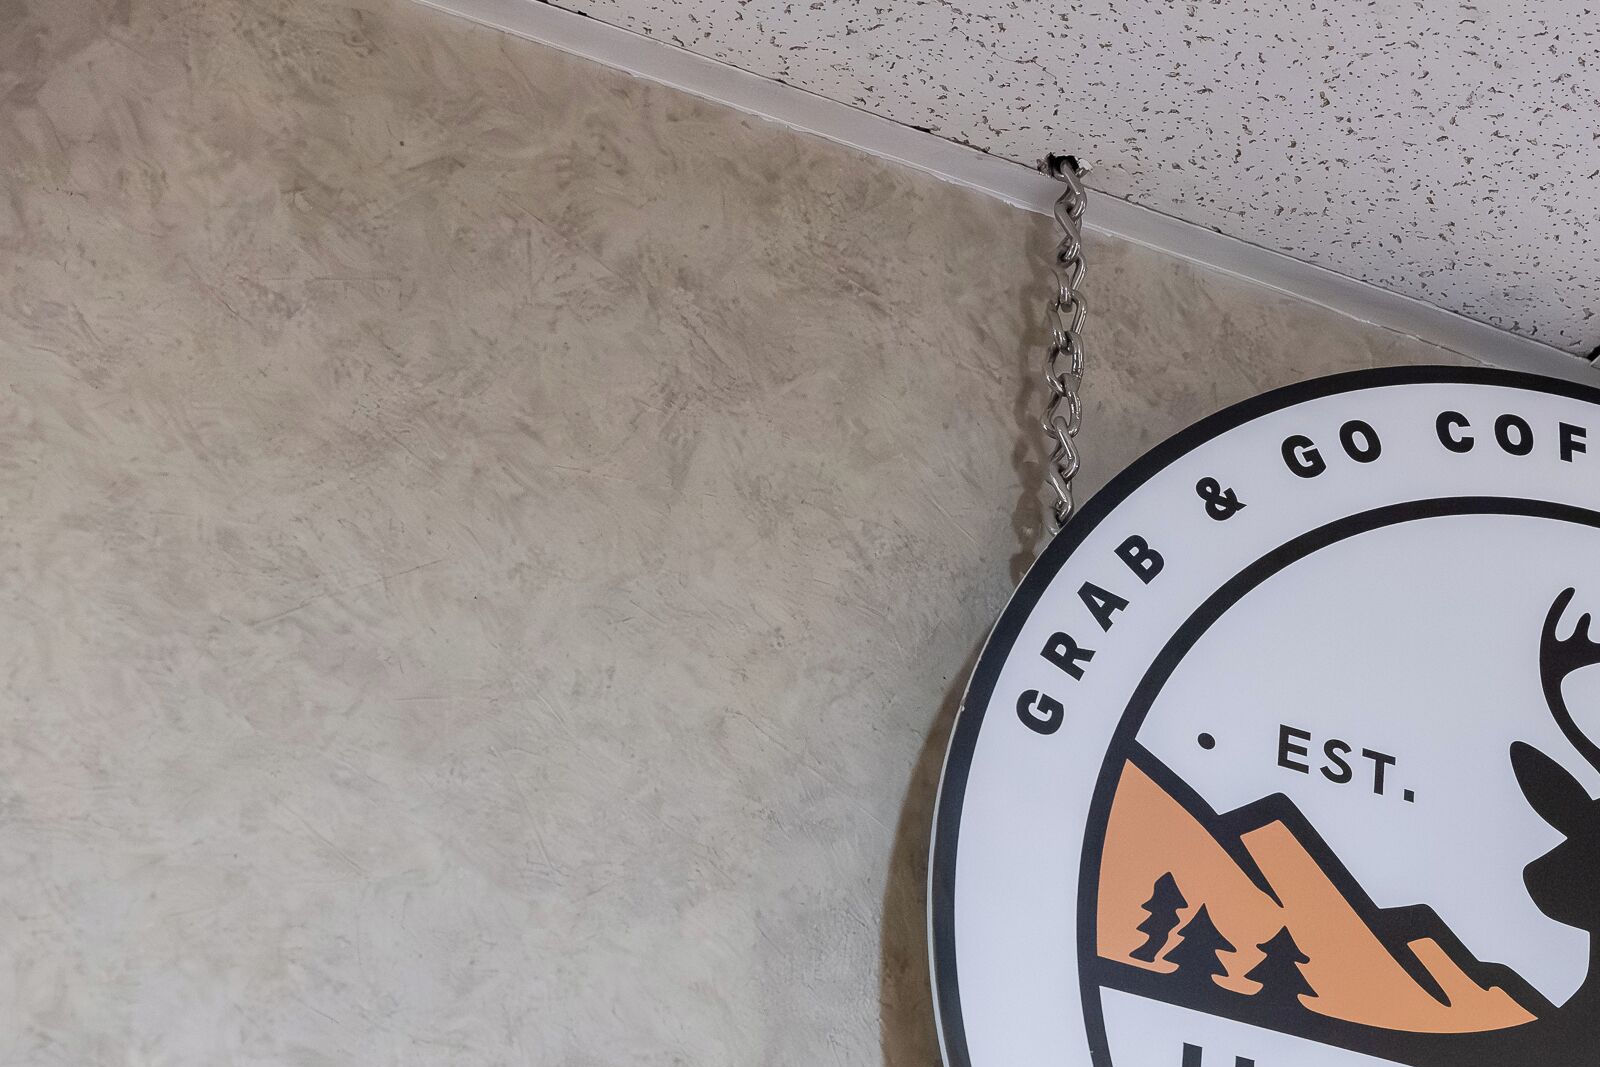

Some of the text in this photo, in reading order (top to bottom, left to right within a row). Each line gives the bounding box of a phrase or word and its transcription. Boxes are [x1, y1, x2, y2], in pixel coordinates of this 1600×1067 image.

[1015, 534, 1165, 735] GRAB
[1195, 476, 1247, 521] &
[1281, 419, 1382, 479] GO
[1277, 723, 1415, 803] EST.
